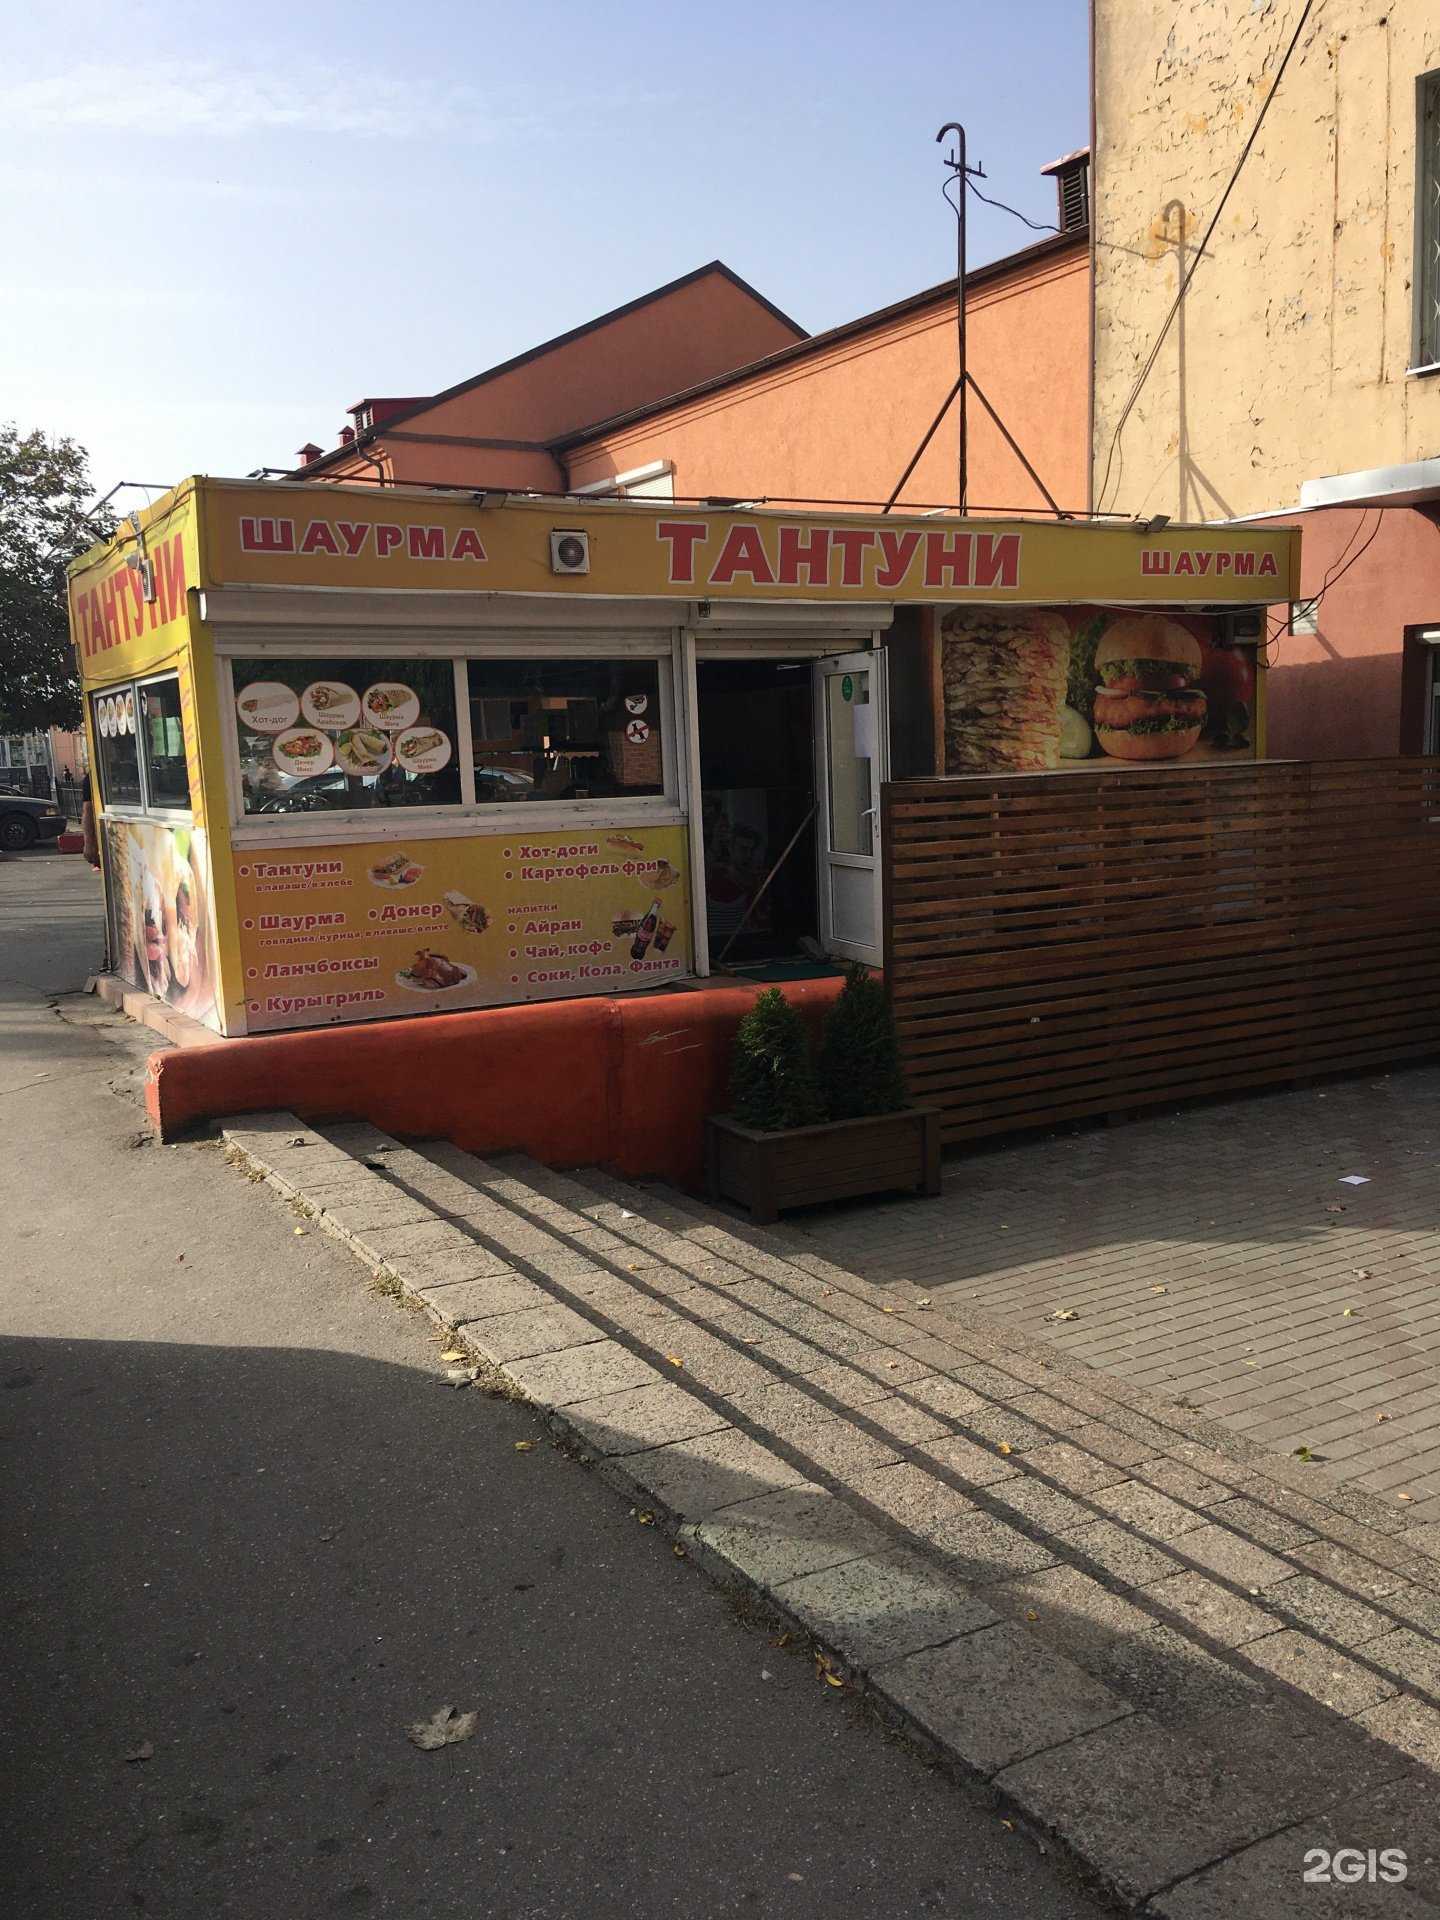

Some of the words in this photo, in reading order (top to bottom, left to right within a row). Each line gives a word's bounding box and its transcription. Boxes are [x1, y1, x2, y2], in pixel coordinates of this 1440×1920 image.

[239, 516, 488, 562] ШАУРМА
[657, 521, 1021, 589] ТАНТУНИ
[1141, 550, 1279, 577] ШАУРМА
[78, 532, 187, 657] ТАНТУНИ
[519, 844, 599, 859] Хот-доги
[254, 861, 342, 882] Тантуни
[521, 863, 620, 882] Картофель
[623, 859, 657, 877] фри
[260, 912, 345, 931] Шаурма
[381, 904, 443, 921] Донер
[524, 919, 582, 936] Айран
[526, 944, 564, 959] Чай,
[568, 941, 612, 956] кофе
[264, 957, 379, 978] Ланчбоксы
[528, 970, 575, 984] Соки,
[579, 964, 626, 979] Кола,
[630, 958, 680, 974] Фанта
[266, 995, 322, 1013] Куры
[326, 989, 385, 1007] гриль
